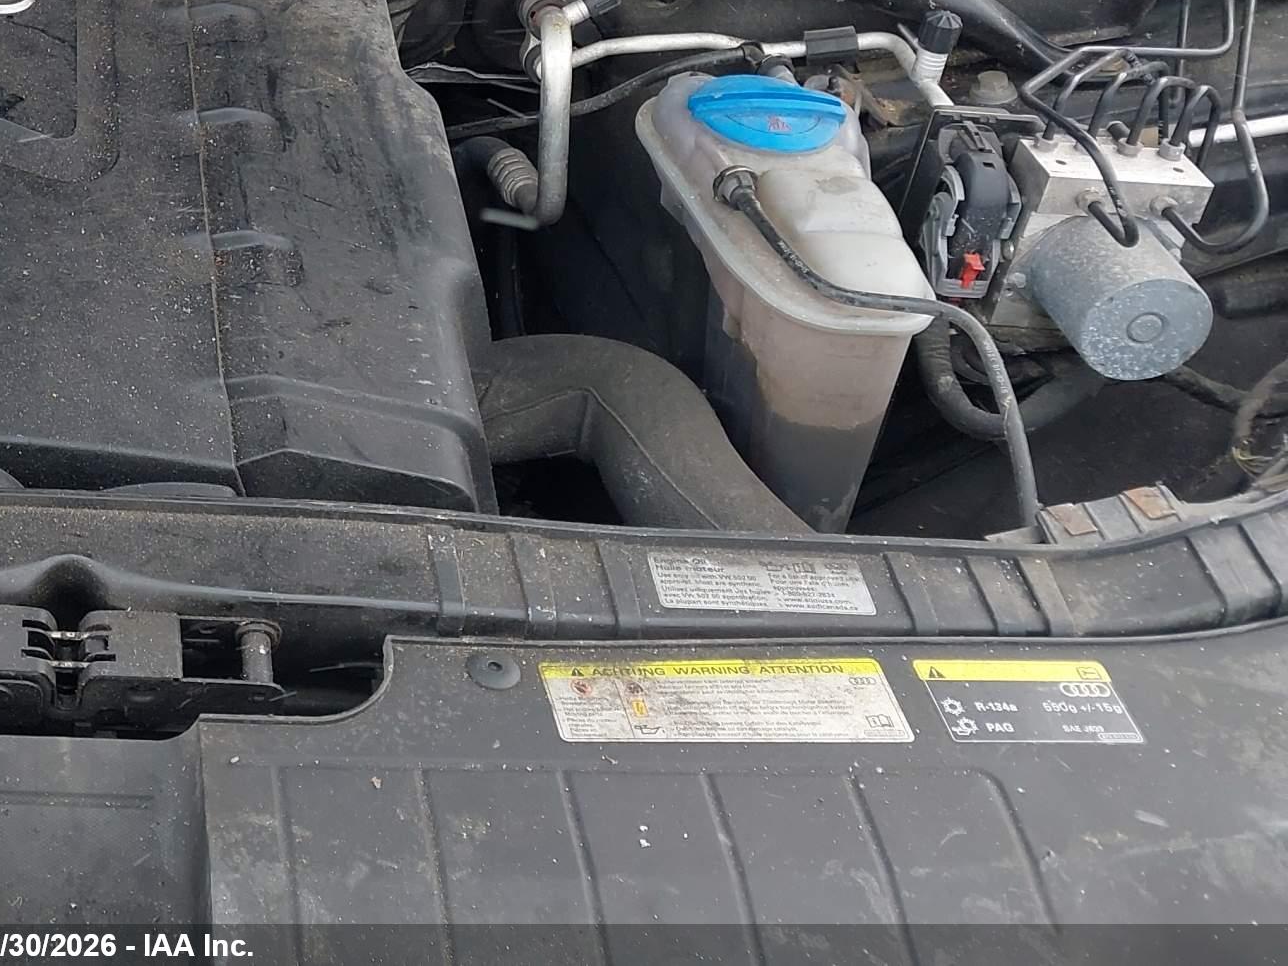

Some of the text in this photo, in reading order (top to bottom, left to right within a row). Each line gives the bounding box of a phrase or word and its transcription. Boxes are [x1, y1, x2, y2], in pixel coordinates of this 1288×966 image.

[592, 664, 844, 677] ACHTUNG WARNING ATTENTION
[974, 702, 1019, 712] R-134a
[985, 722, 1015, 732] PAG
